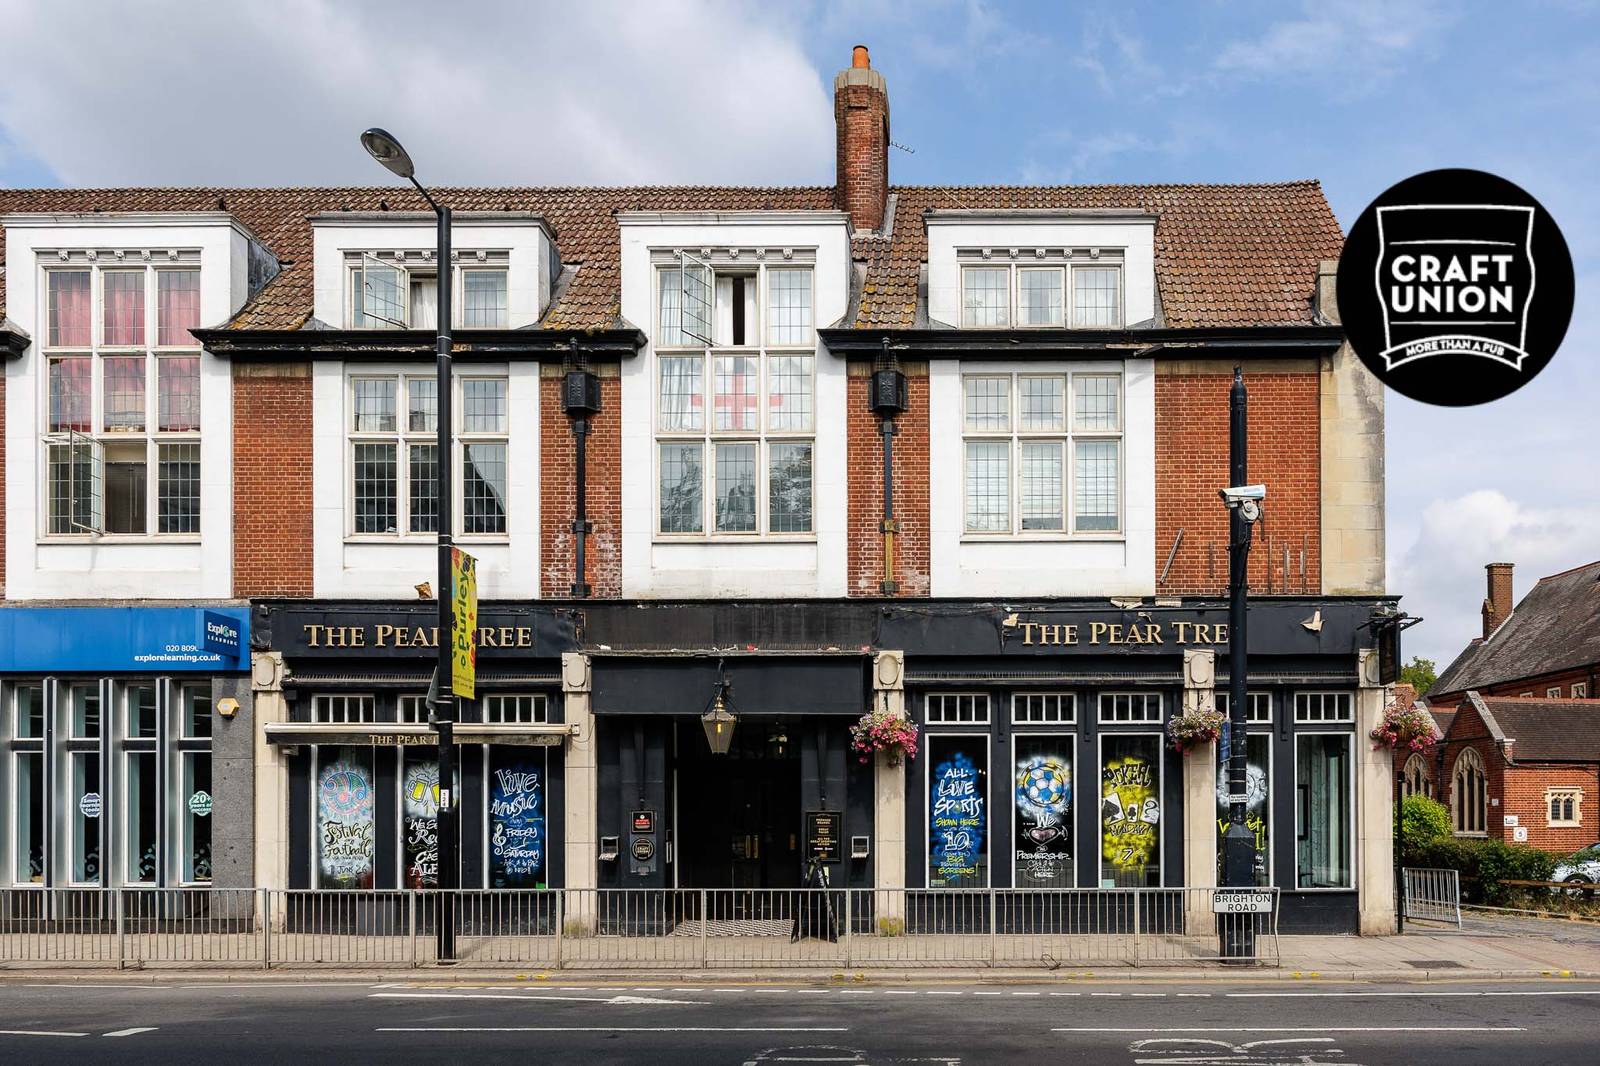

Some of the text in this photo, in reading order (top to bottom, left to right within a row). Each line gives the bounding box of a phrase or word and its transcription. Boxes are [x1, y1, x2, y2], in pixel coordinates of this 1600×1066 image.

[304, 624, 532, 648] THE PEA REE
[1018, 621, 1229, 645] THE PEAR TRE
[207, 635, 238, 646] LEARNING
[134, 653, 221, 662] explorelearning.co.uk
[369, 735, 393, 745] THE
[397, 735, 427, 745] PEAR
[1215, 894, 1271, 903] BRIGHTON
[1228, 904, 1258, 912] ROAD
